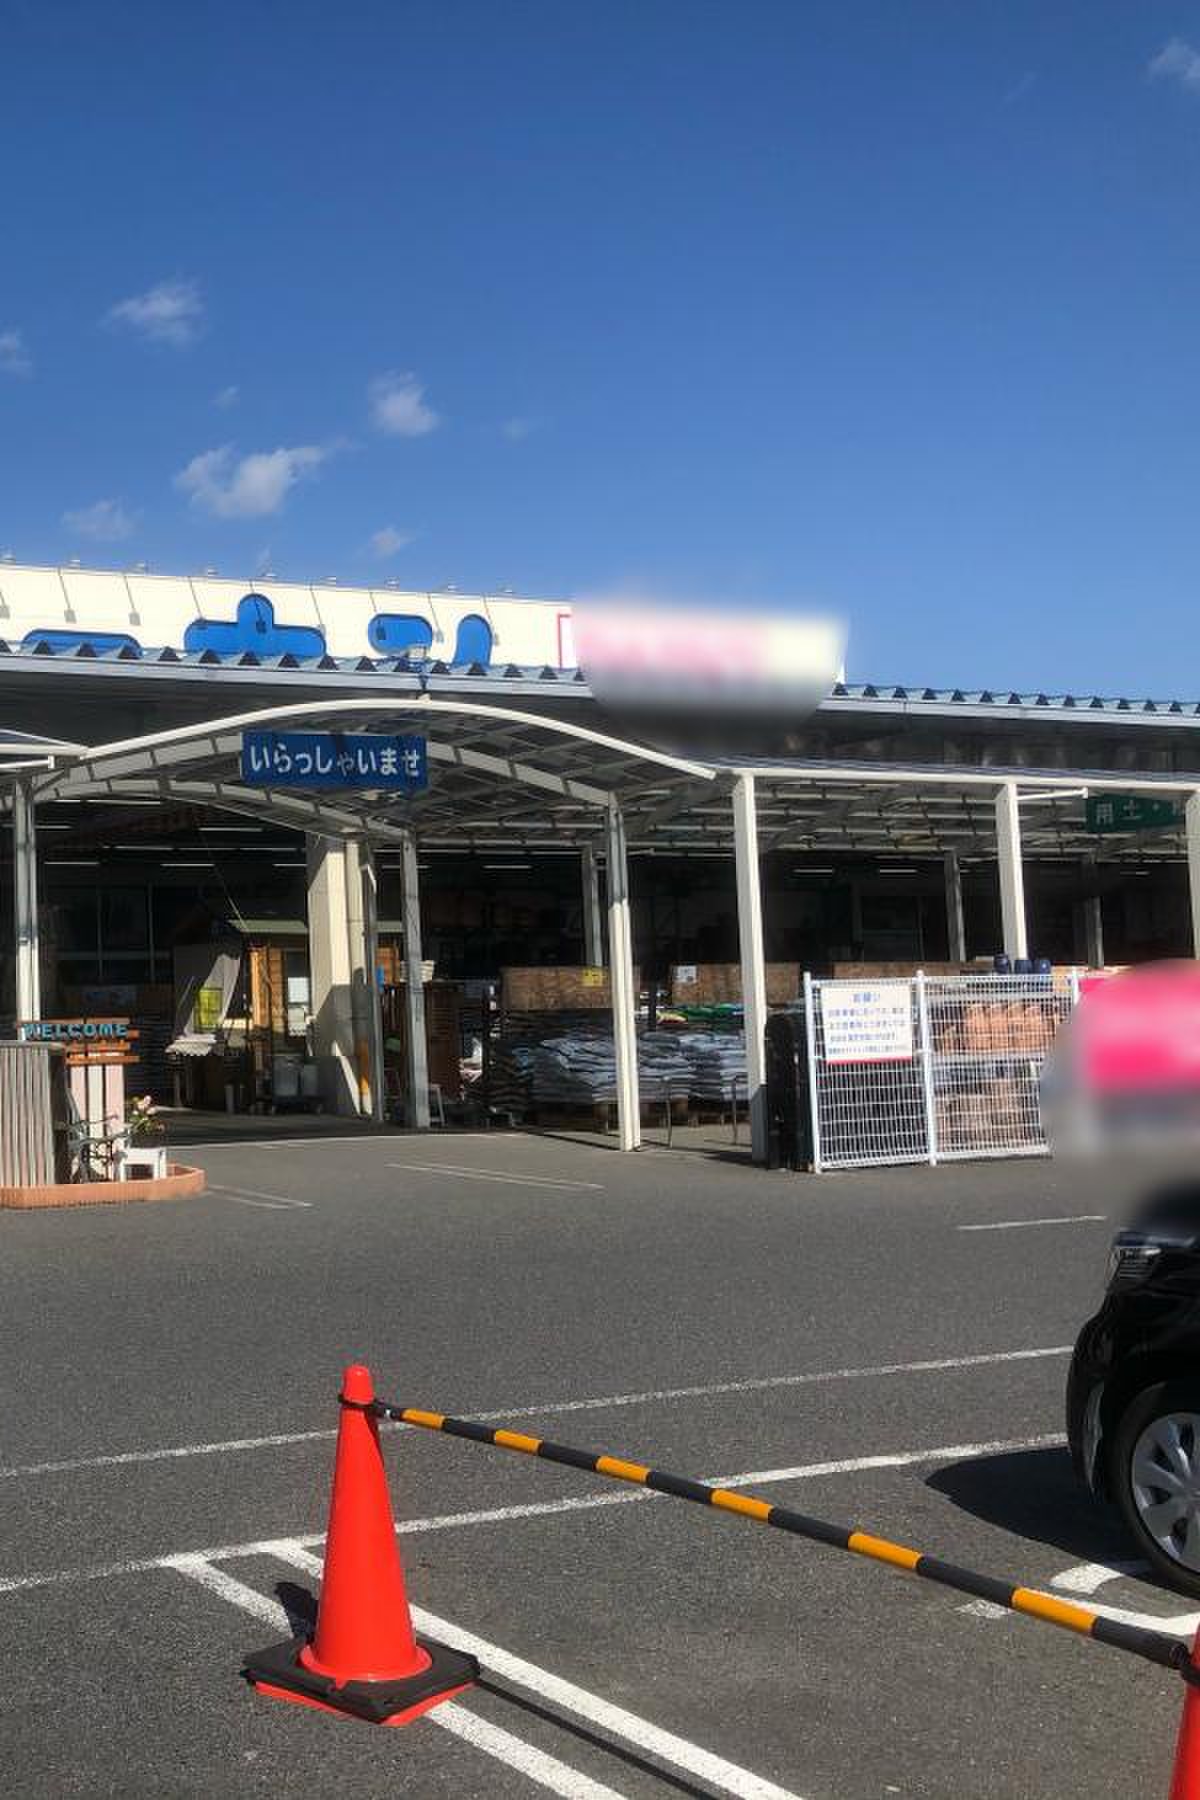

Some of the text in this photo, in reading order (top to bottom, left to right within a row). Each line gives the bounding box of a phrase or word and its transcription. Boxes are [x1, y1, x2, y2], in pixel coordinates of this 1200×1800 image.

[249, 743, 421, 777] いらっしゃいませ
[21, 1022, 129, 1040] WELCOME
